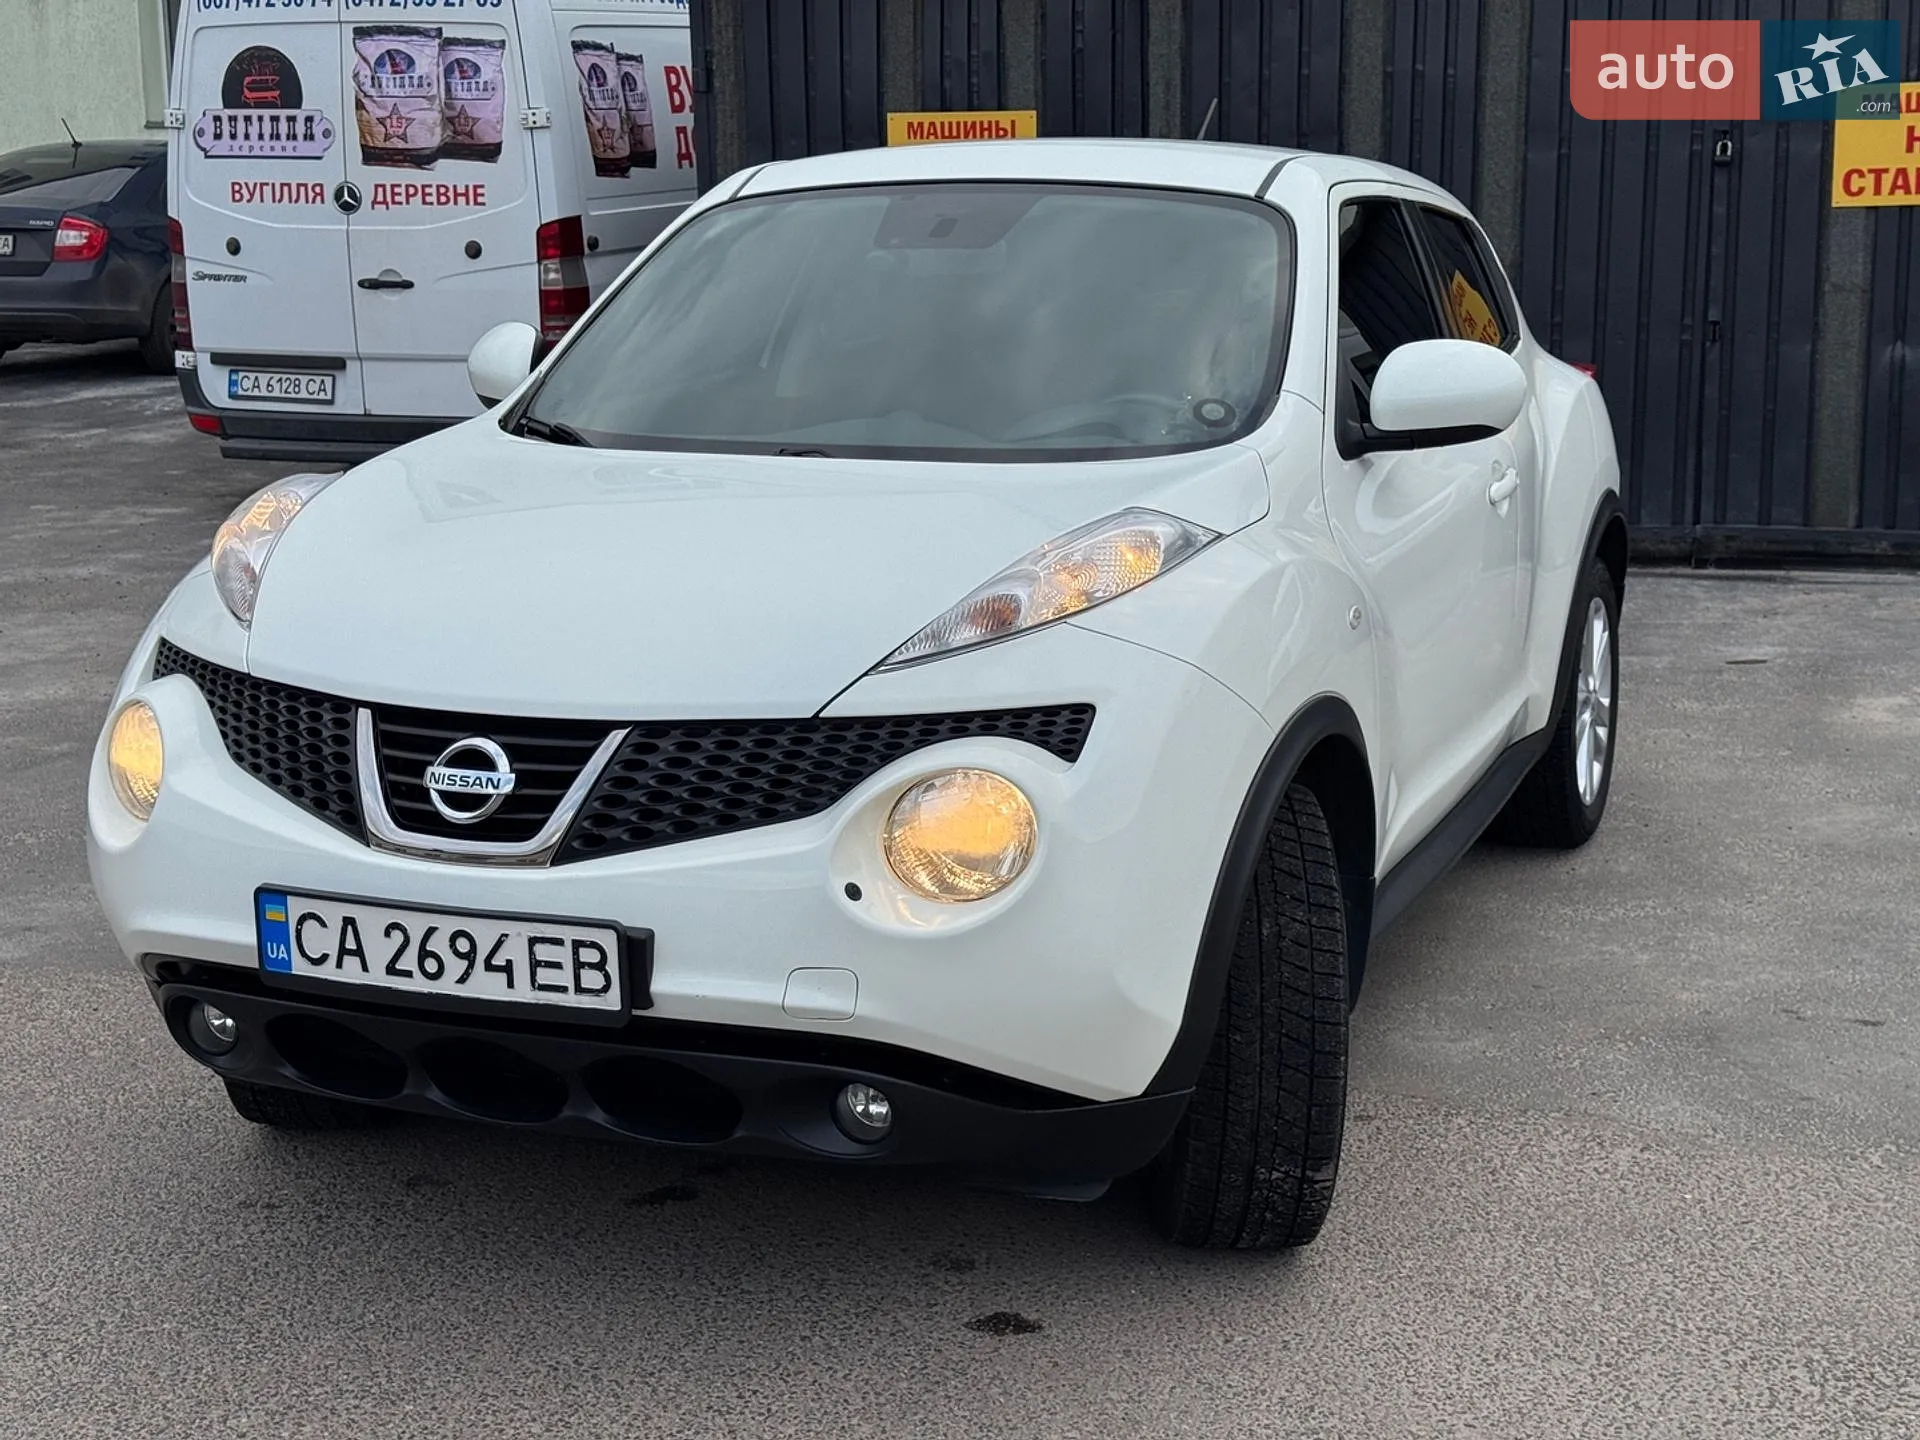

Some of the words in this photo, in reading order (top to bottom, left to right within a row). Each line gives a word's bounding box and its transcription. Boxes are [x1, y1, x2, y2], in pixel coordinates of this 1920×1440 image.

[906, 119, 1016, 140] МАШИНЫ
[230, 181, 325, 205] ВУГІЛЛЯ
[371, 183, 486, 210] ДЕРЕВНЕ
[239, 375, 261, 393] CA
[266, 376, 301, 395] 6128
[305, 378, 328, 397] CA
[429, 770, 502, 790] NISSAN
[266, 942, 289, 961] UA
[295, 911, 370, 974] CA
[384, 921, 515, 990] 2694
[527, 933, 613, 997] EB
